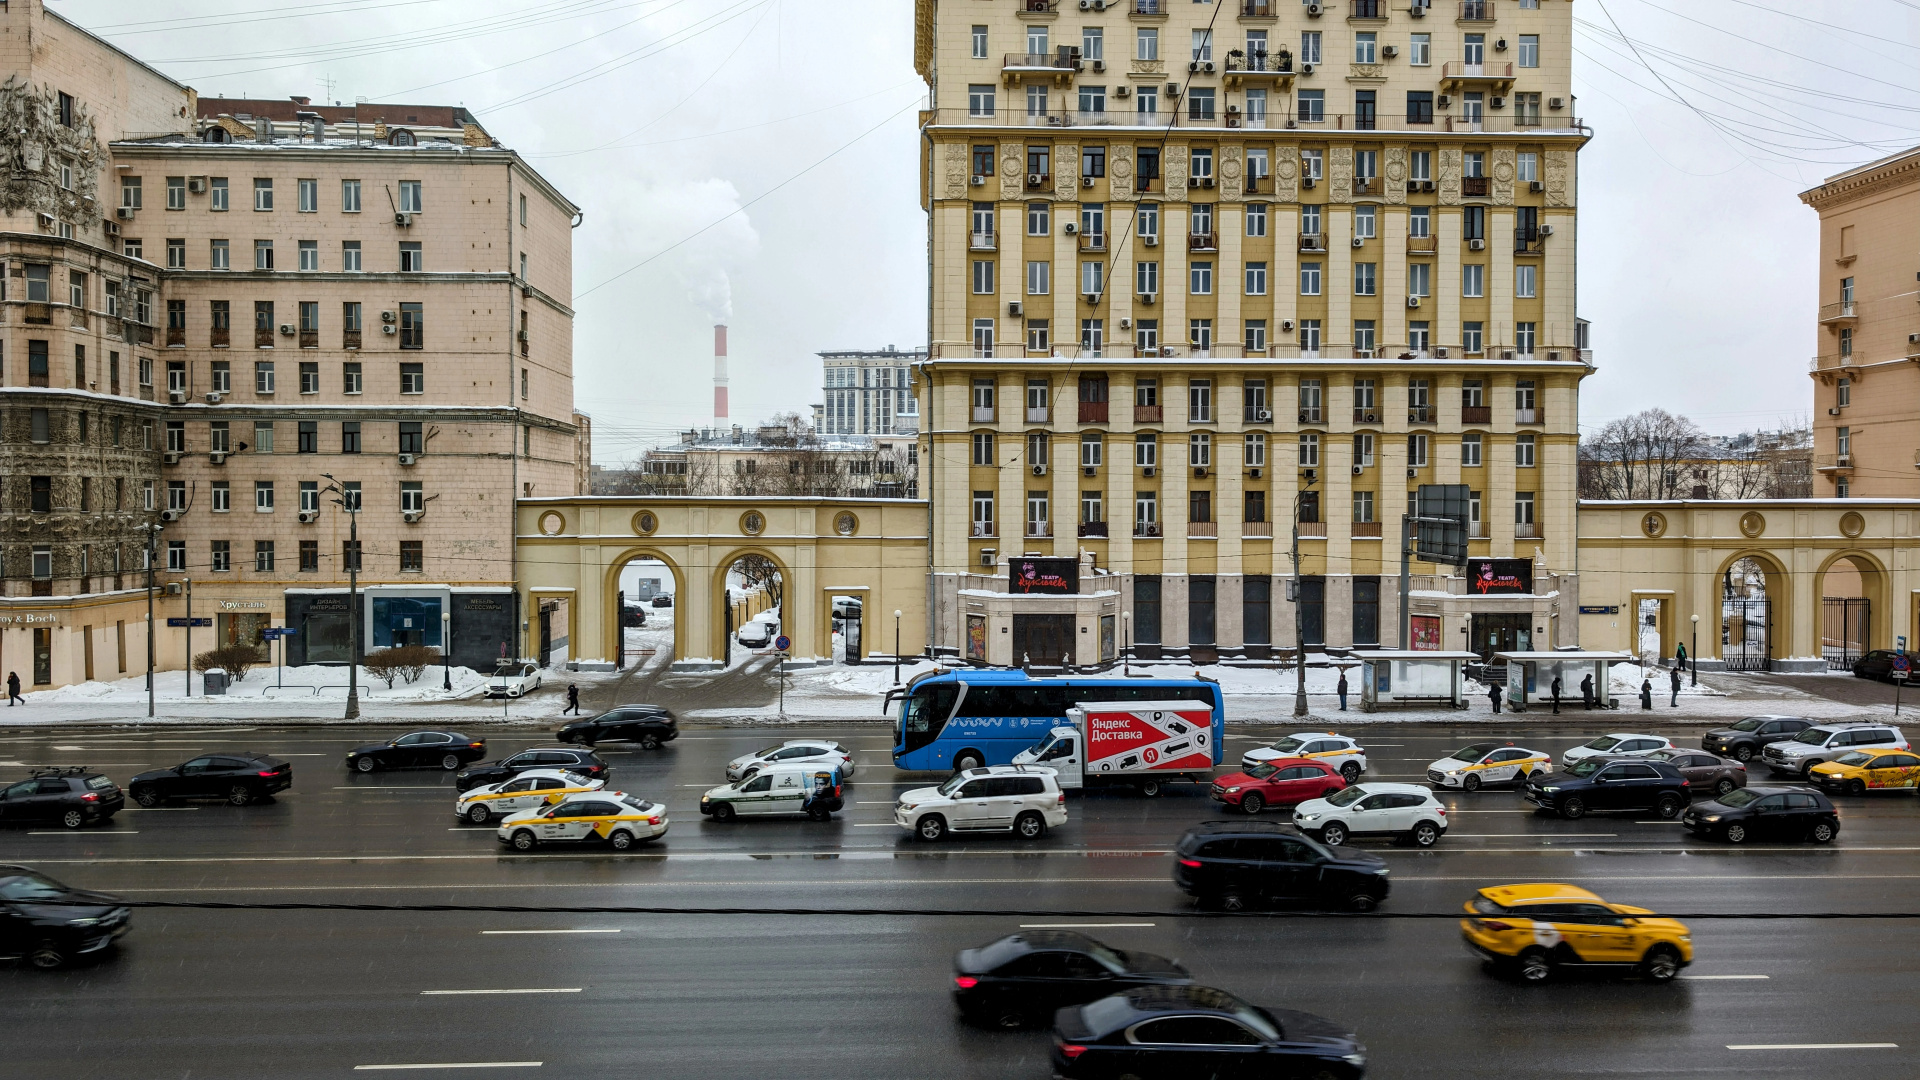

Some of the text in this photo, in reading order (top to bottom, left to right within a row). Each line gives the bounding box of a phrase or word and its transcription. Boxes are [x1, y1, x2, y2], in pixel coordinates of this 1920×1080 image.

[219, 600, 266, 609] Хрусталь
[15, 615, 23, 623] &
[26, 613, 56, 623] Boch
[1091, 718, 1131, 730] Яндекс
[1091, 730, 1143, 742] Доставка
